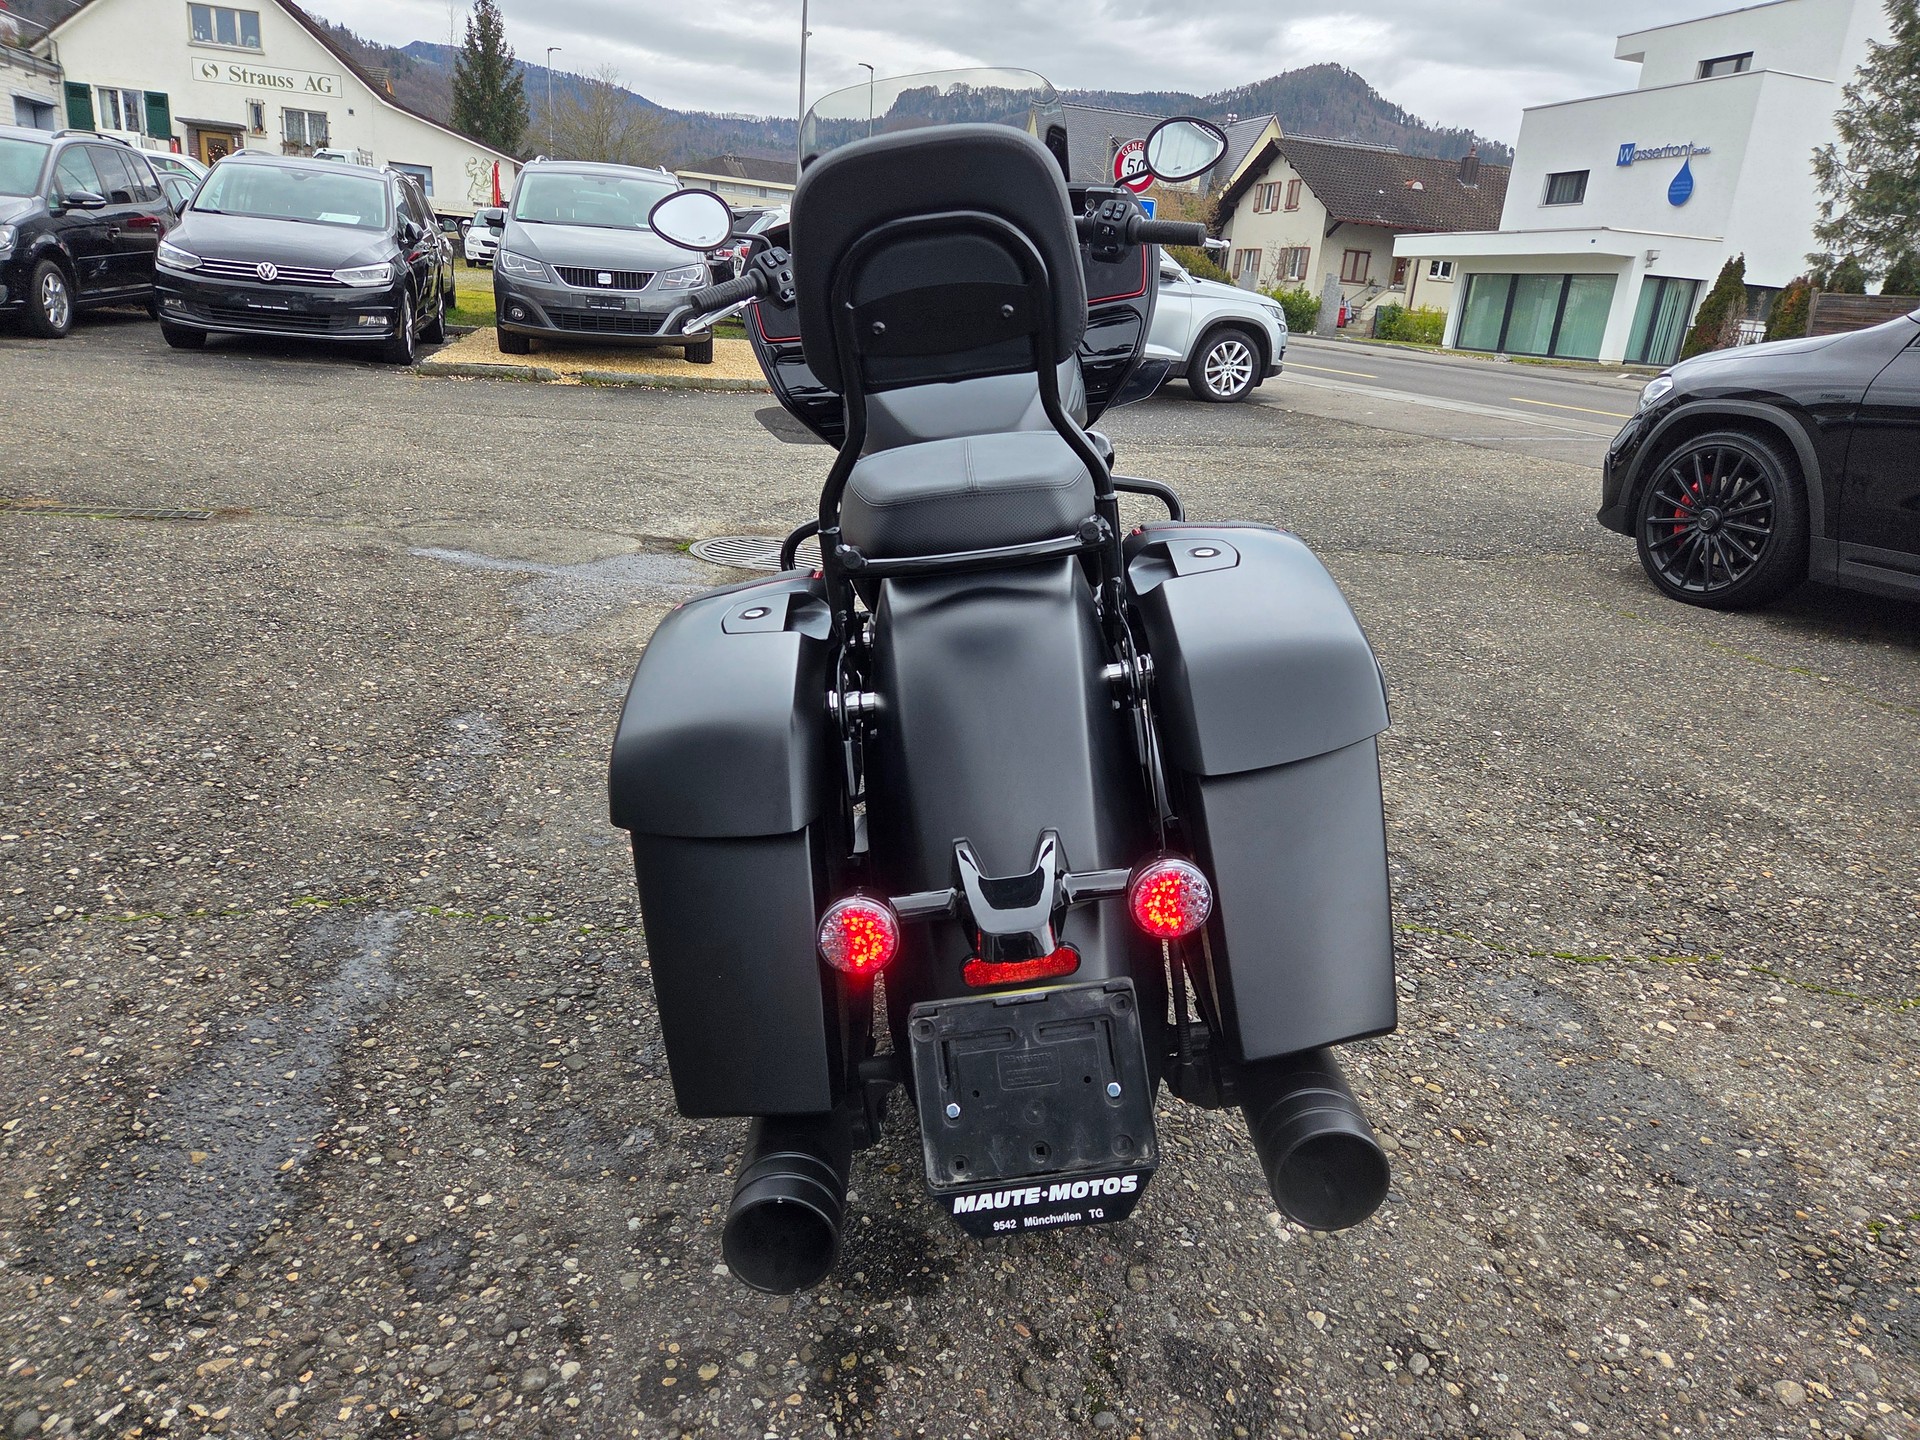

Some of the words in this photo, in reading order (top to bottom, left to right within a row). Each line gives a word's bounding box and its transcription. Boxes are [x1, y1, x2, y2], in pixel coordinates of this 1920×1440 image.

[228, 65, 294, 89] Strauss
[304, 75, 333, 94] AG
[1618, 141, 1693, 163] Wasserfront
[1126, 158, 1146, 175] 50
[993, 1219, 1017, 1232] 9542
[1023, 1211, 1082, 1228] Münchwilen
[1088, 1207, 1104, 1219] TG
